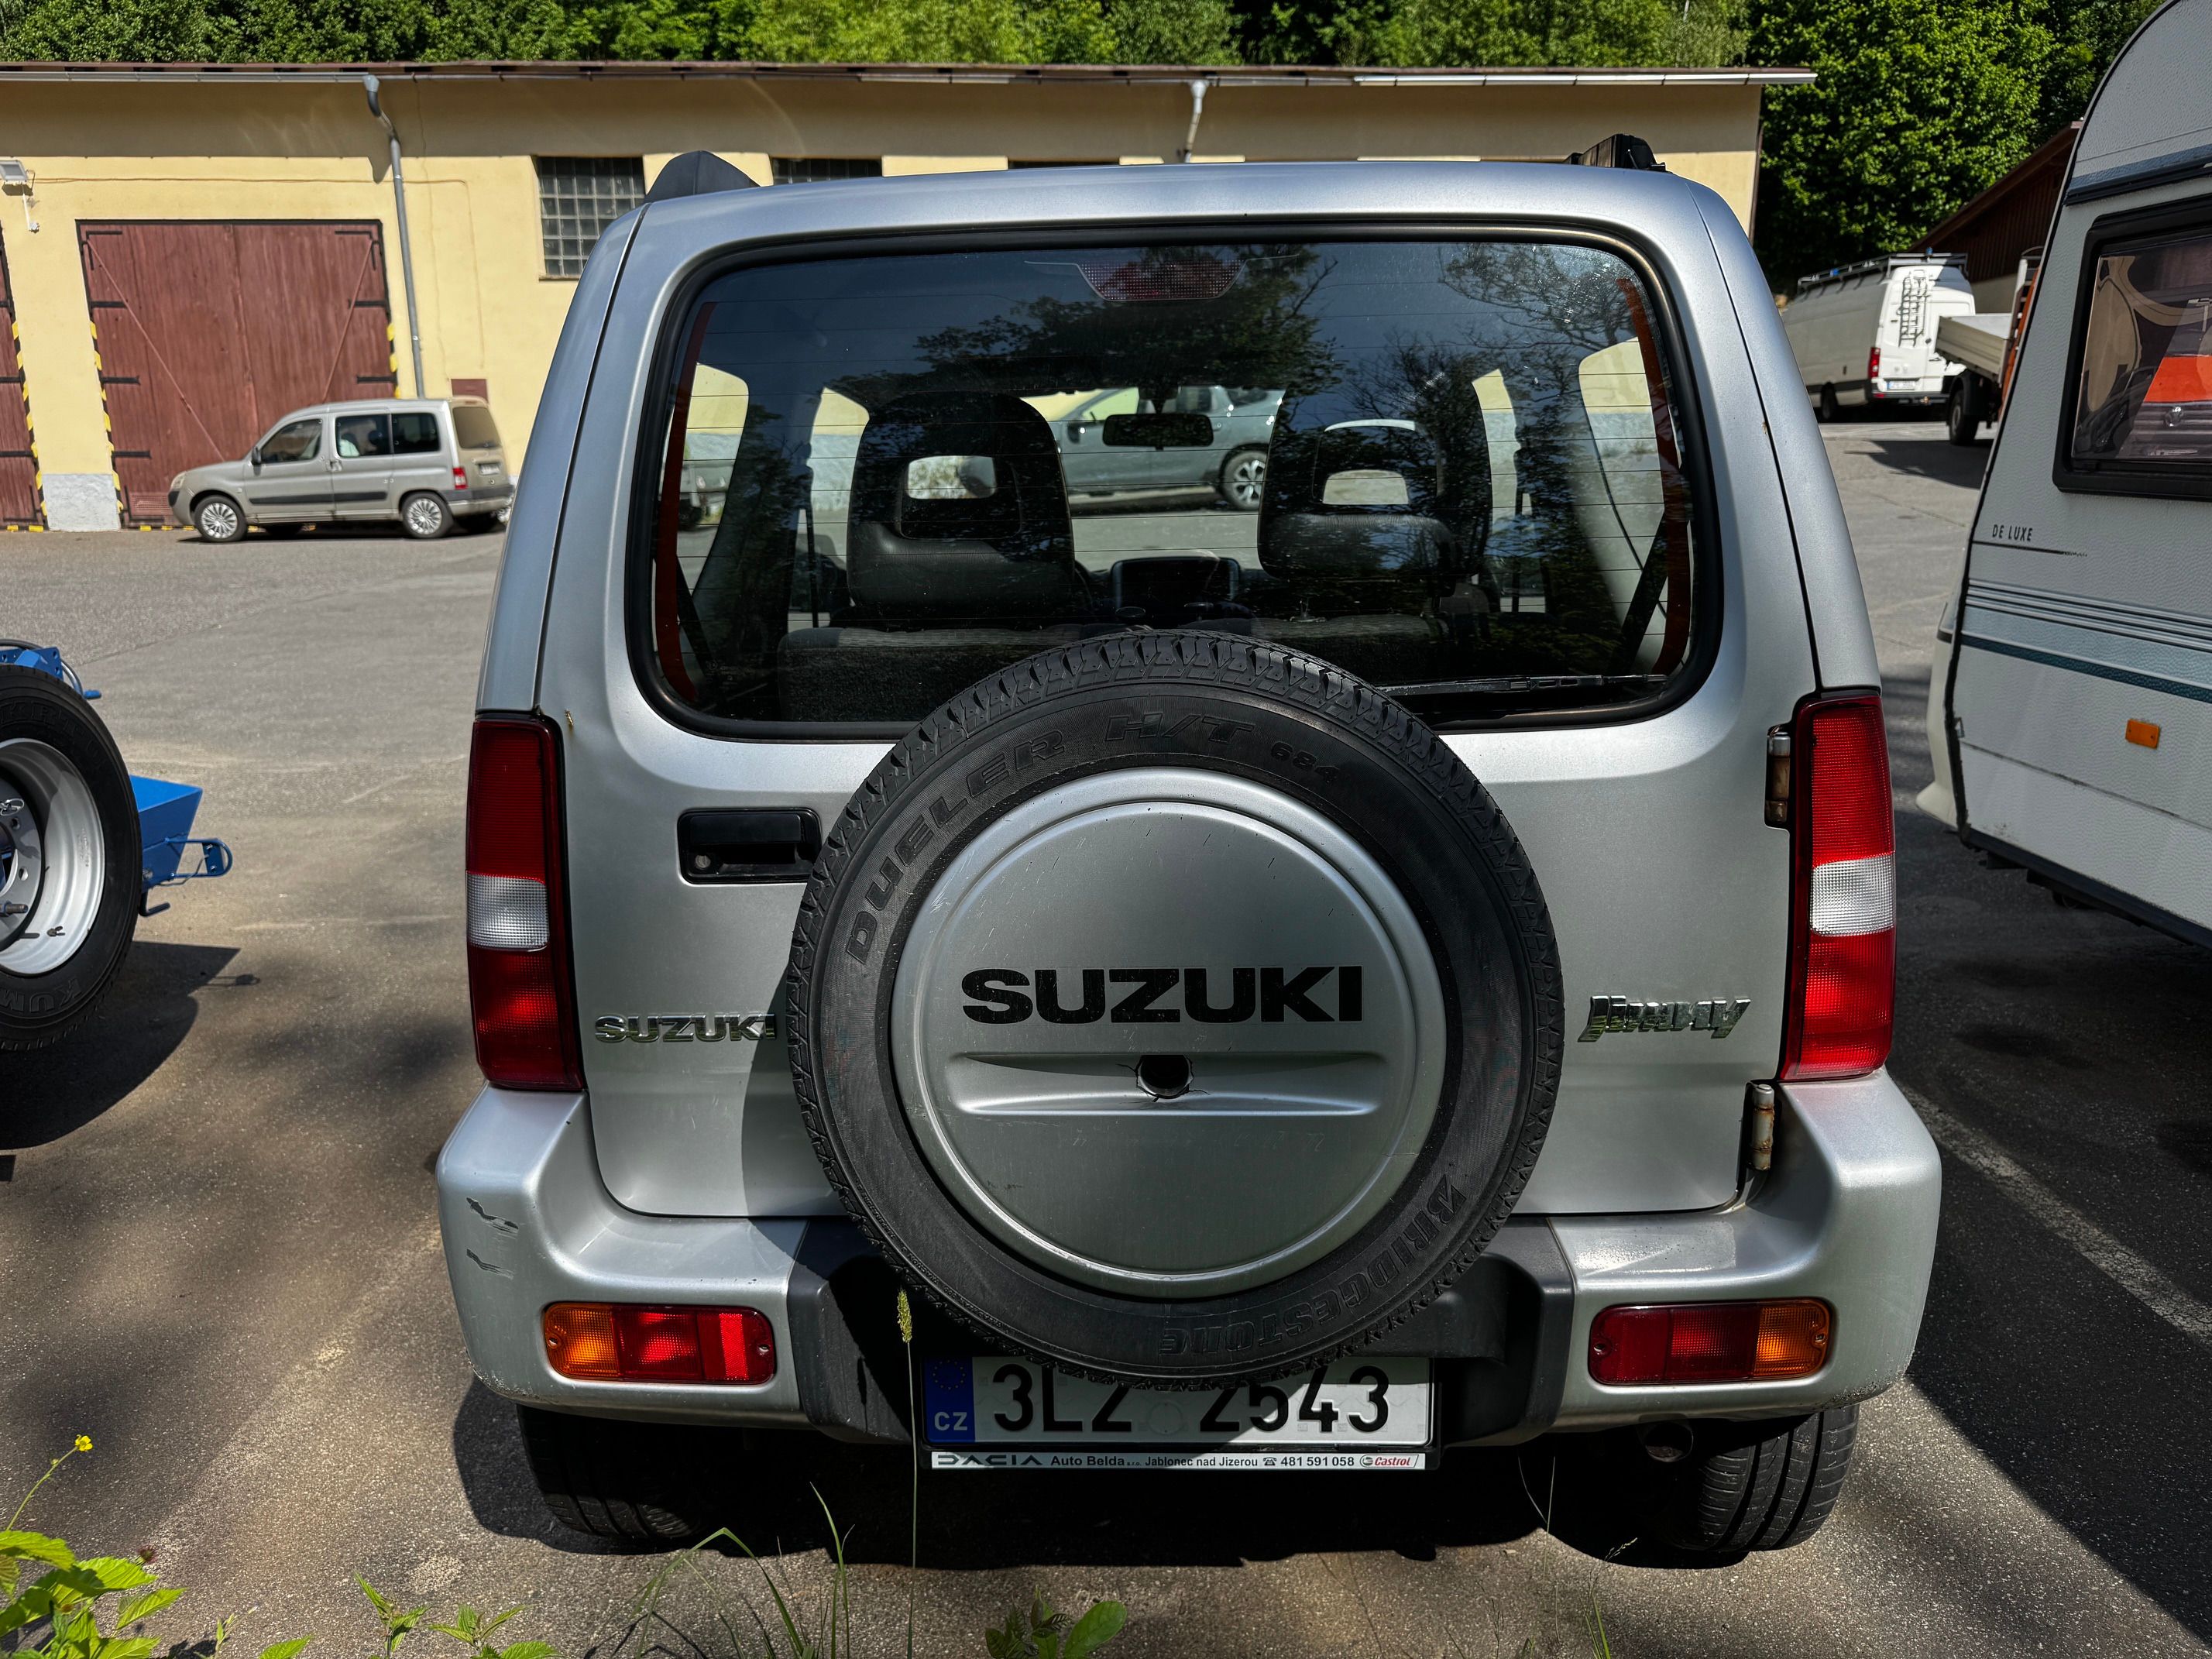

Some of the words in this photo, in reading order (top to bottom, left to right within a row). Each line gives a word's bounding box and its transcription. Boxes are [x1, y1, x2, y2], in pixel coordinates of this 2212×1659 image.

[1992, 524, 2004, 538] DE
[2008, 525, 2033, 541] LUXE
[846, 730, 1066, 965] DUELER
[1105, 711, 1255, 744] H/T
[960, 965, 1363, 1025] SUZUKI
[594, 1014, 776, 1043] SUZUKI
[1577, 995, 1751, 1042] Jimny
[1159, 1174, 1467, 1356] BRIDGESTONE
[1199, 1365, 1389, 1433] 2543
[934, 1410, 968, 1431] CZ
[937, 1454, 1043, 1465] DACIA
[1051, 1455, 1083, 1466] Auto
[1087, 1455, 1125, 1466] Belda
[1145, 1456, 1194, 1467] Jablonec
[1197, 1457, 1216, 1467] nad
[1219, 1457, 1258, 1467] Jizerou
[1280, 1457, 1302, 1467] 481
[1307, 1457, 1328, 1467] 591
[1331, 1457, 1355, 1467] 058
[1374, 1457, 1411, 1466] Castrol
